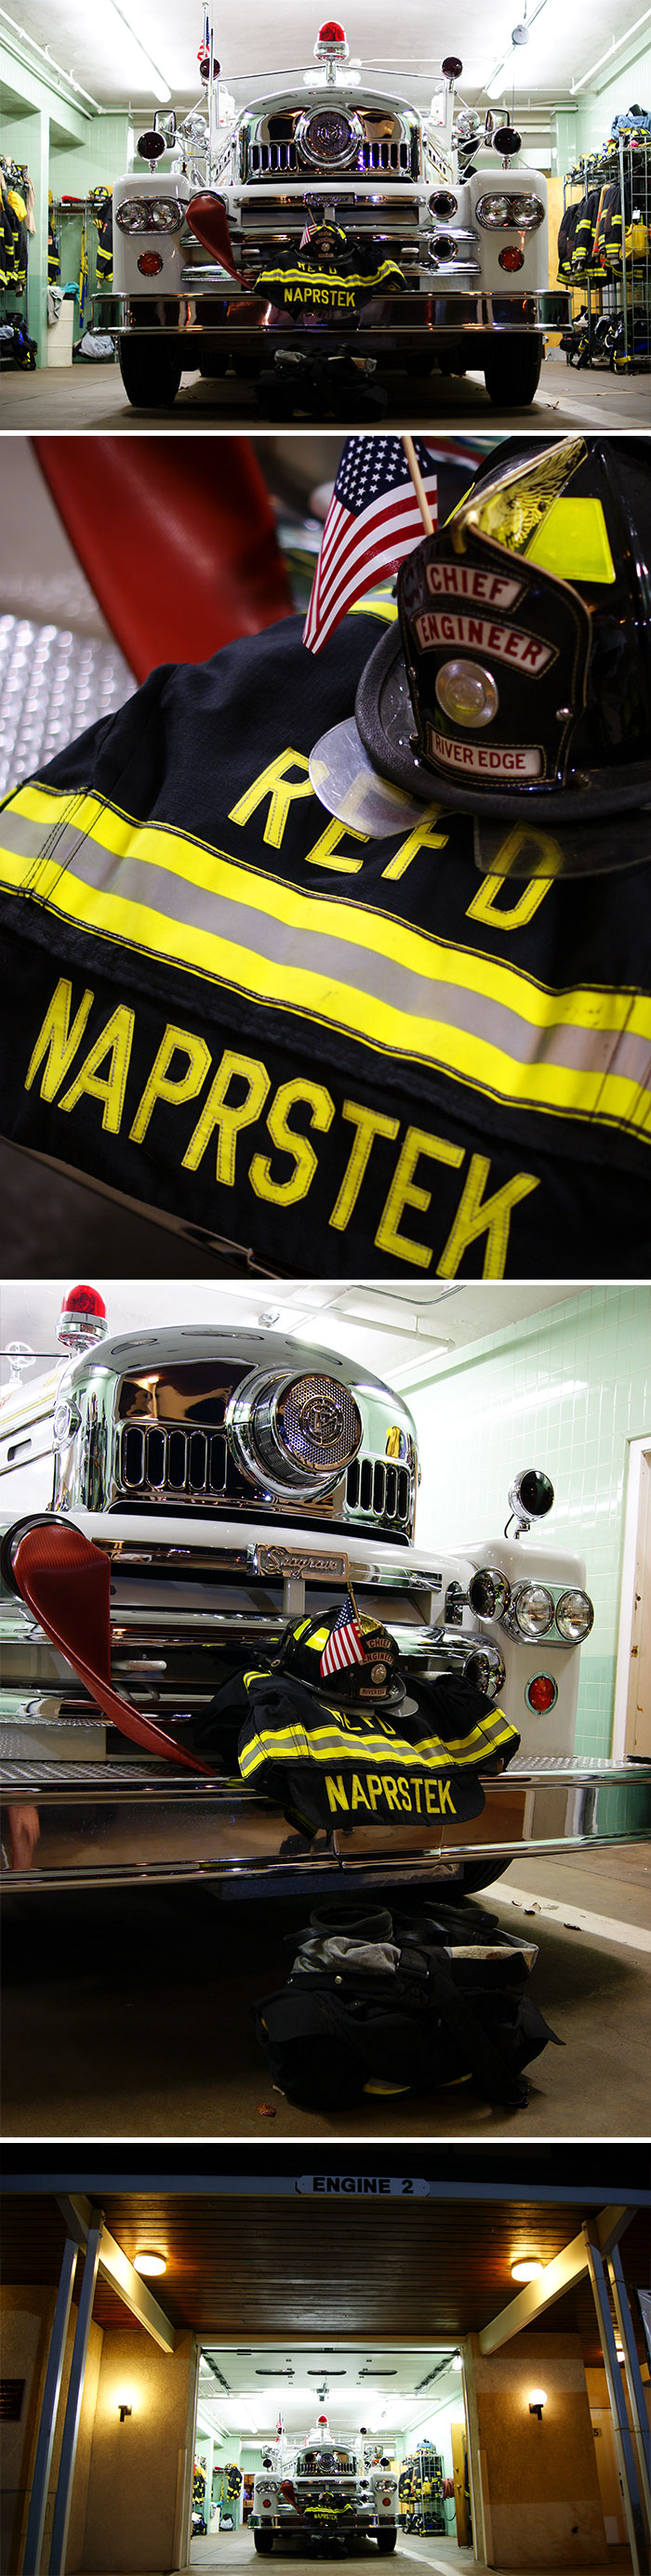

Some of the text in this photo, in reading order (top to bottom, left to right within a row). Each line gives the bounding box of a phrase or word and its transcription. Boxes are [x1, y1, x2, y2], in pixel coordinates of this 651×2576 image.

[284, 287, 356, 308] NAPRSTEK
[430, 566, 511, 601] CHIEF
[421, 615, 544, 666] ENGINEER
[434, 734, 526, 770] RIVER EDGE
[24, 977, 540, 1280] NAPRSTEK
[266, 1549, 338, 1578] Seagrave
[369, 1639, 391, 1648] CHIEF
[325, 1774, 457, 1815] NAPRSTEK
[312, 2176, 414, 2194] ENGINE 2
